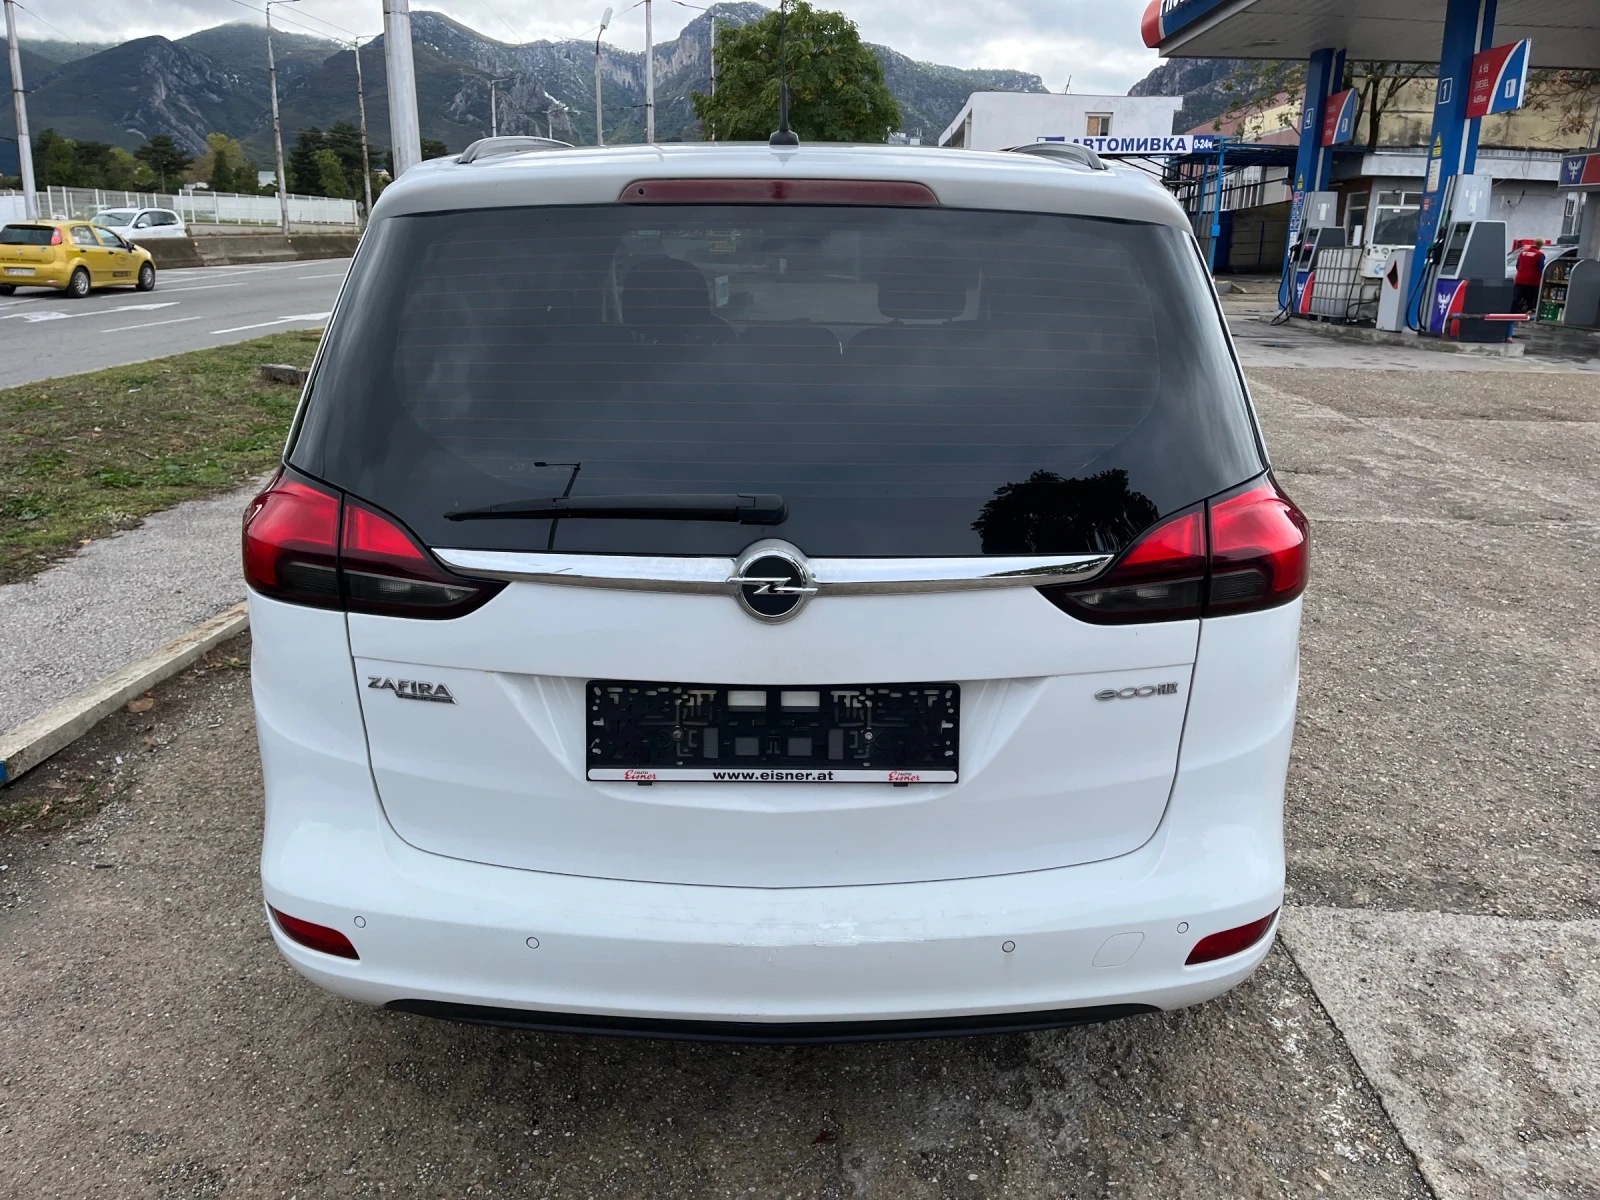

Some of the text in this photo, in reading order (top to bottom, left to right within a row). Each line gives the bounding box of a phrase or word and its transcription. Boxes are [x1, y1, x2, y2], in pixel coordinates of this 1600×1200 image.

[367, 676, 454, 697] ZAFIRA
[624, 770, 656, 780] Eisner
[712, 771, 834, 780] www.eisner.at
[888, 770, 920, 781] Eisner
